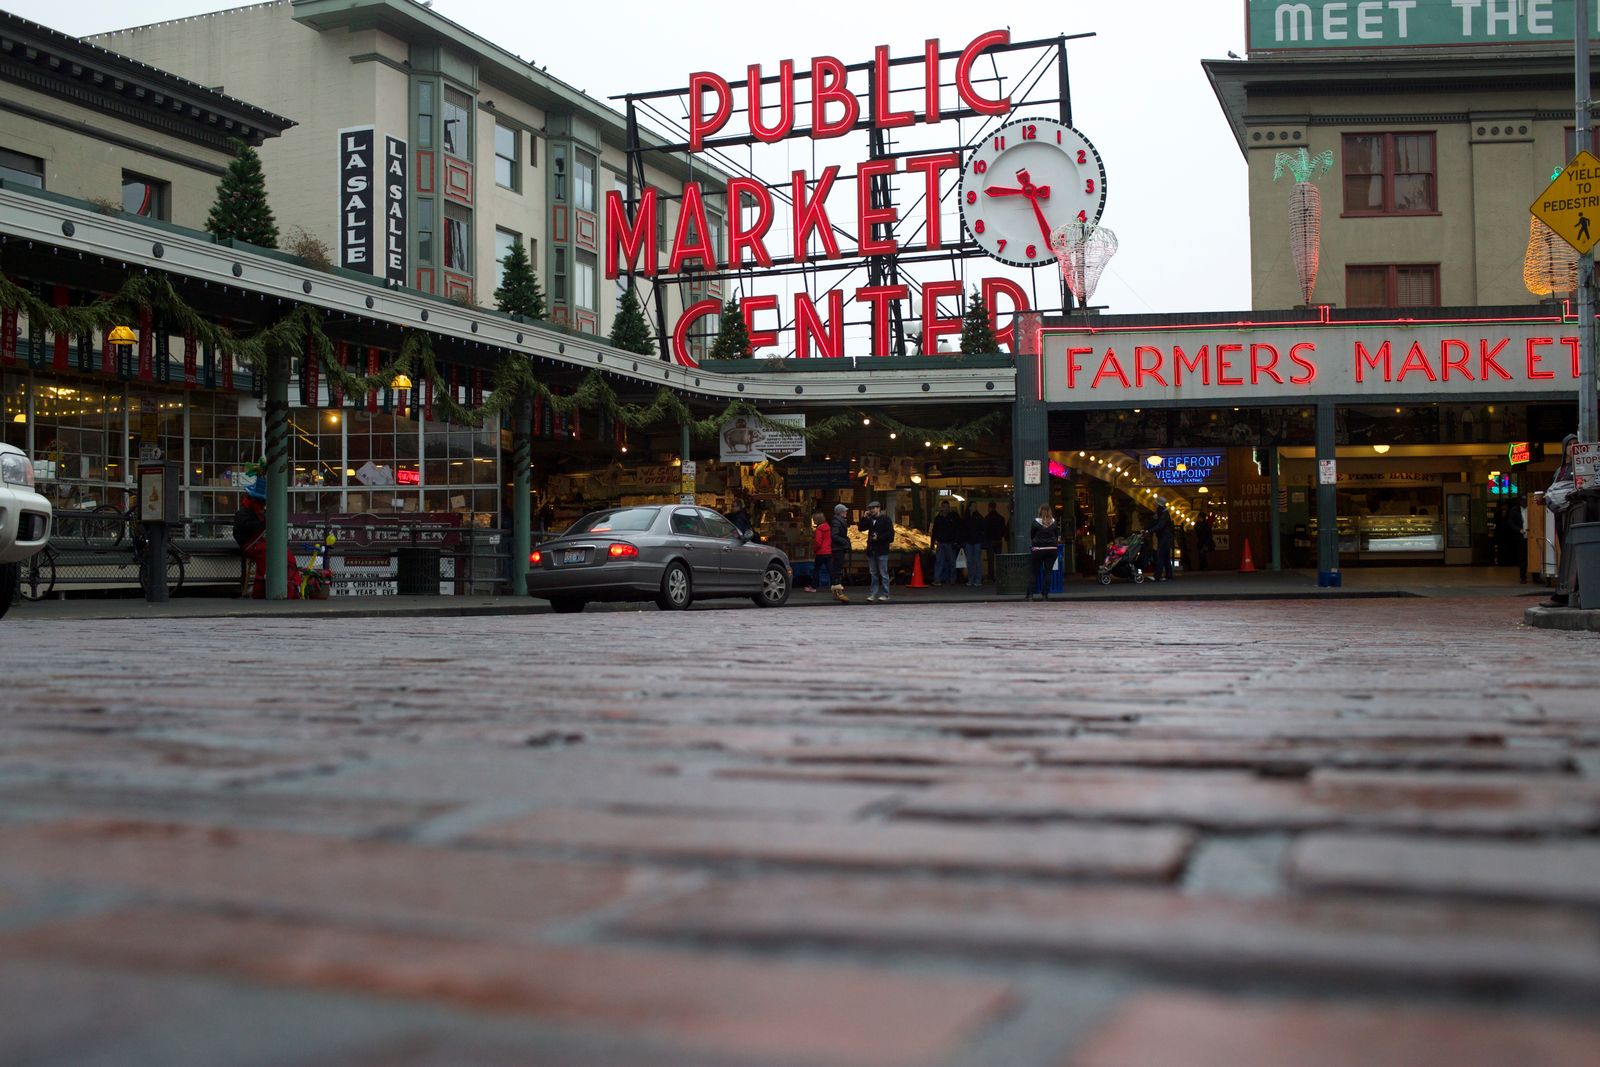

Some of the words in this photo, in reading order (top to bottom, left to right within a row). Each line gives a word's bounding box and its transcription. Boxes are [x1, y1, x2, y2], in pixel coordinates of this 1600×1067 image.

[1274, 1, 1416, 42] MEET
[1451, 0, 1554, 36] THE
[689, 29, 1012, 152] PUBLIC
[1021, 124, 1037, 140] 12
[1056, 130, 1062, 145] 1
[994, 136, 1005, 151] 11
[1076, 149, 1087, 164] 2
[973, 159, 987, 174] 10
[1567, 167, 1600, 181] YIELD
[1085, 179, 1095, 193] 3
[1577, 183, 1592, 194] TO
[966, 190, 977, 204] 9
[605, 152, 960, 280] MARKET
[974, 219, 985, 233] 8
[996, 239, 1007, 253] 7
[1025, 244, 1036, 258] 6
[673, 277, 1030, 369] CENTER
[1066, 342, 1316, 389] FARMERS
[1354, 337, 1581, 383] MARKET
[1144, 455, 1222, 469] WTERFRONT
[1155, 469, 1212, 479] VIEWPOINT
[1389, 472, 1434, 481] BAKERY
[1232, 499, 1272, 507] MARKE
[1240, 511, 1272, 523] LEVEL
[287, 524, 355, 541] MARET
[362, 525, 446, 541] THEAER
[382, 588, 394, 596] EVE
